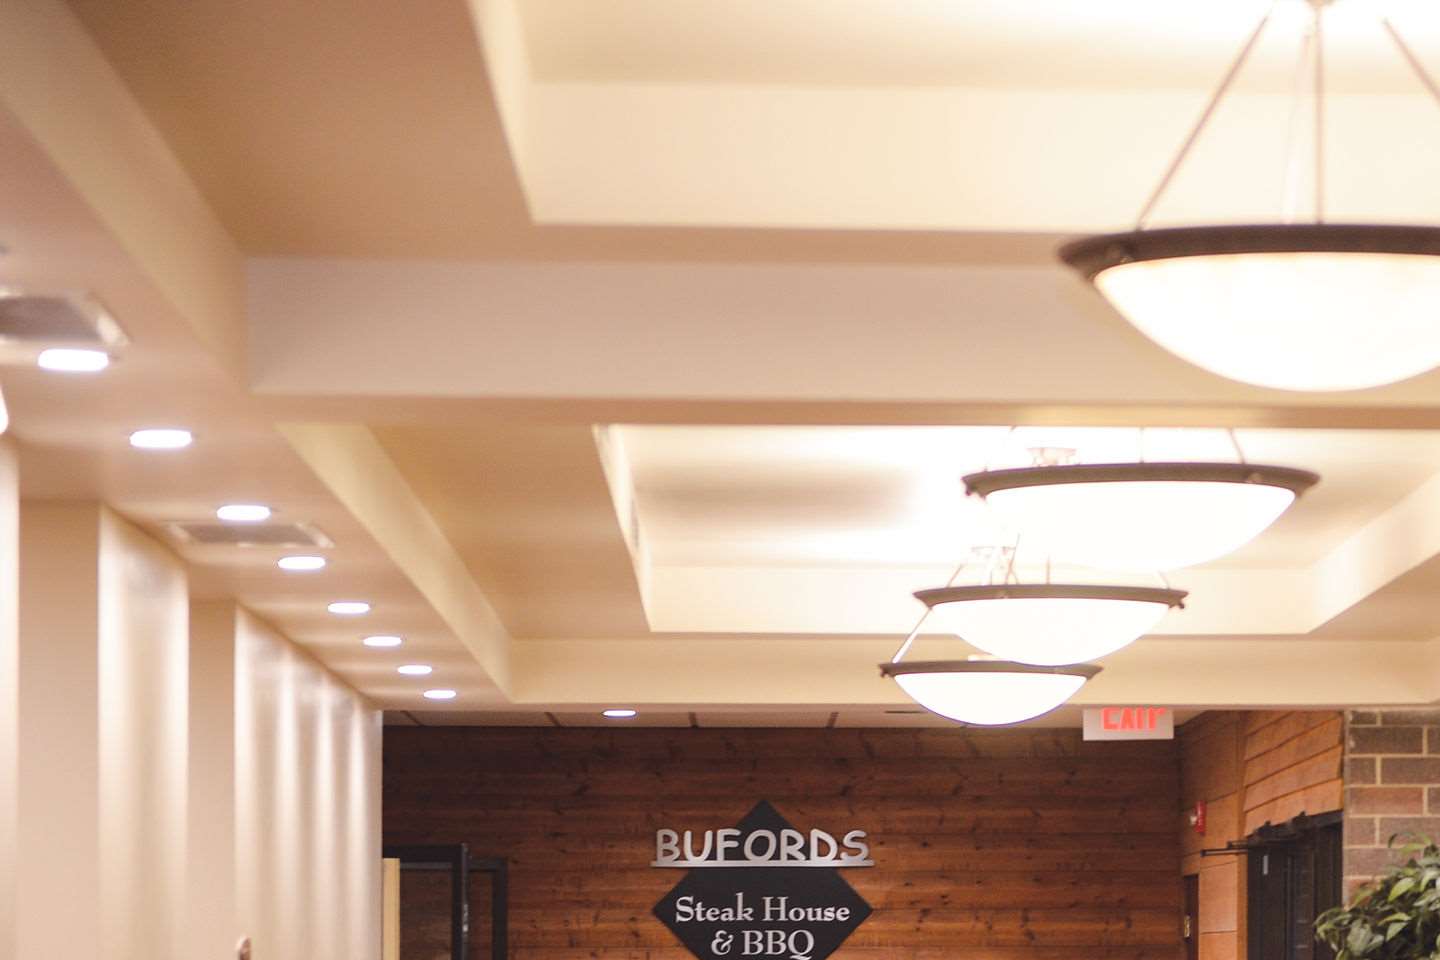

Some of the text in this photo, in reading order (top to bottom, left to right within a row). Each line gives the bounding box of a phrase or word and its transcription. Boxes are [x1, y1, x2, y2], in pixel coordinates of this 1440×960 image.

[656, 828, 870, 862] BUFORDS
[675, 892, 850, 922] Steak House
[711, 929, 815, 960] & BBQ
